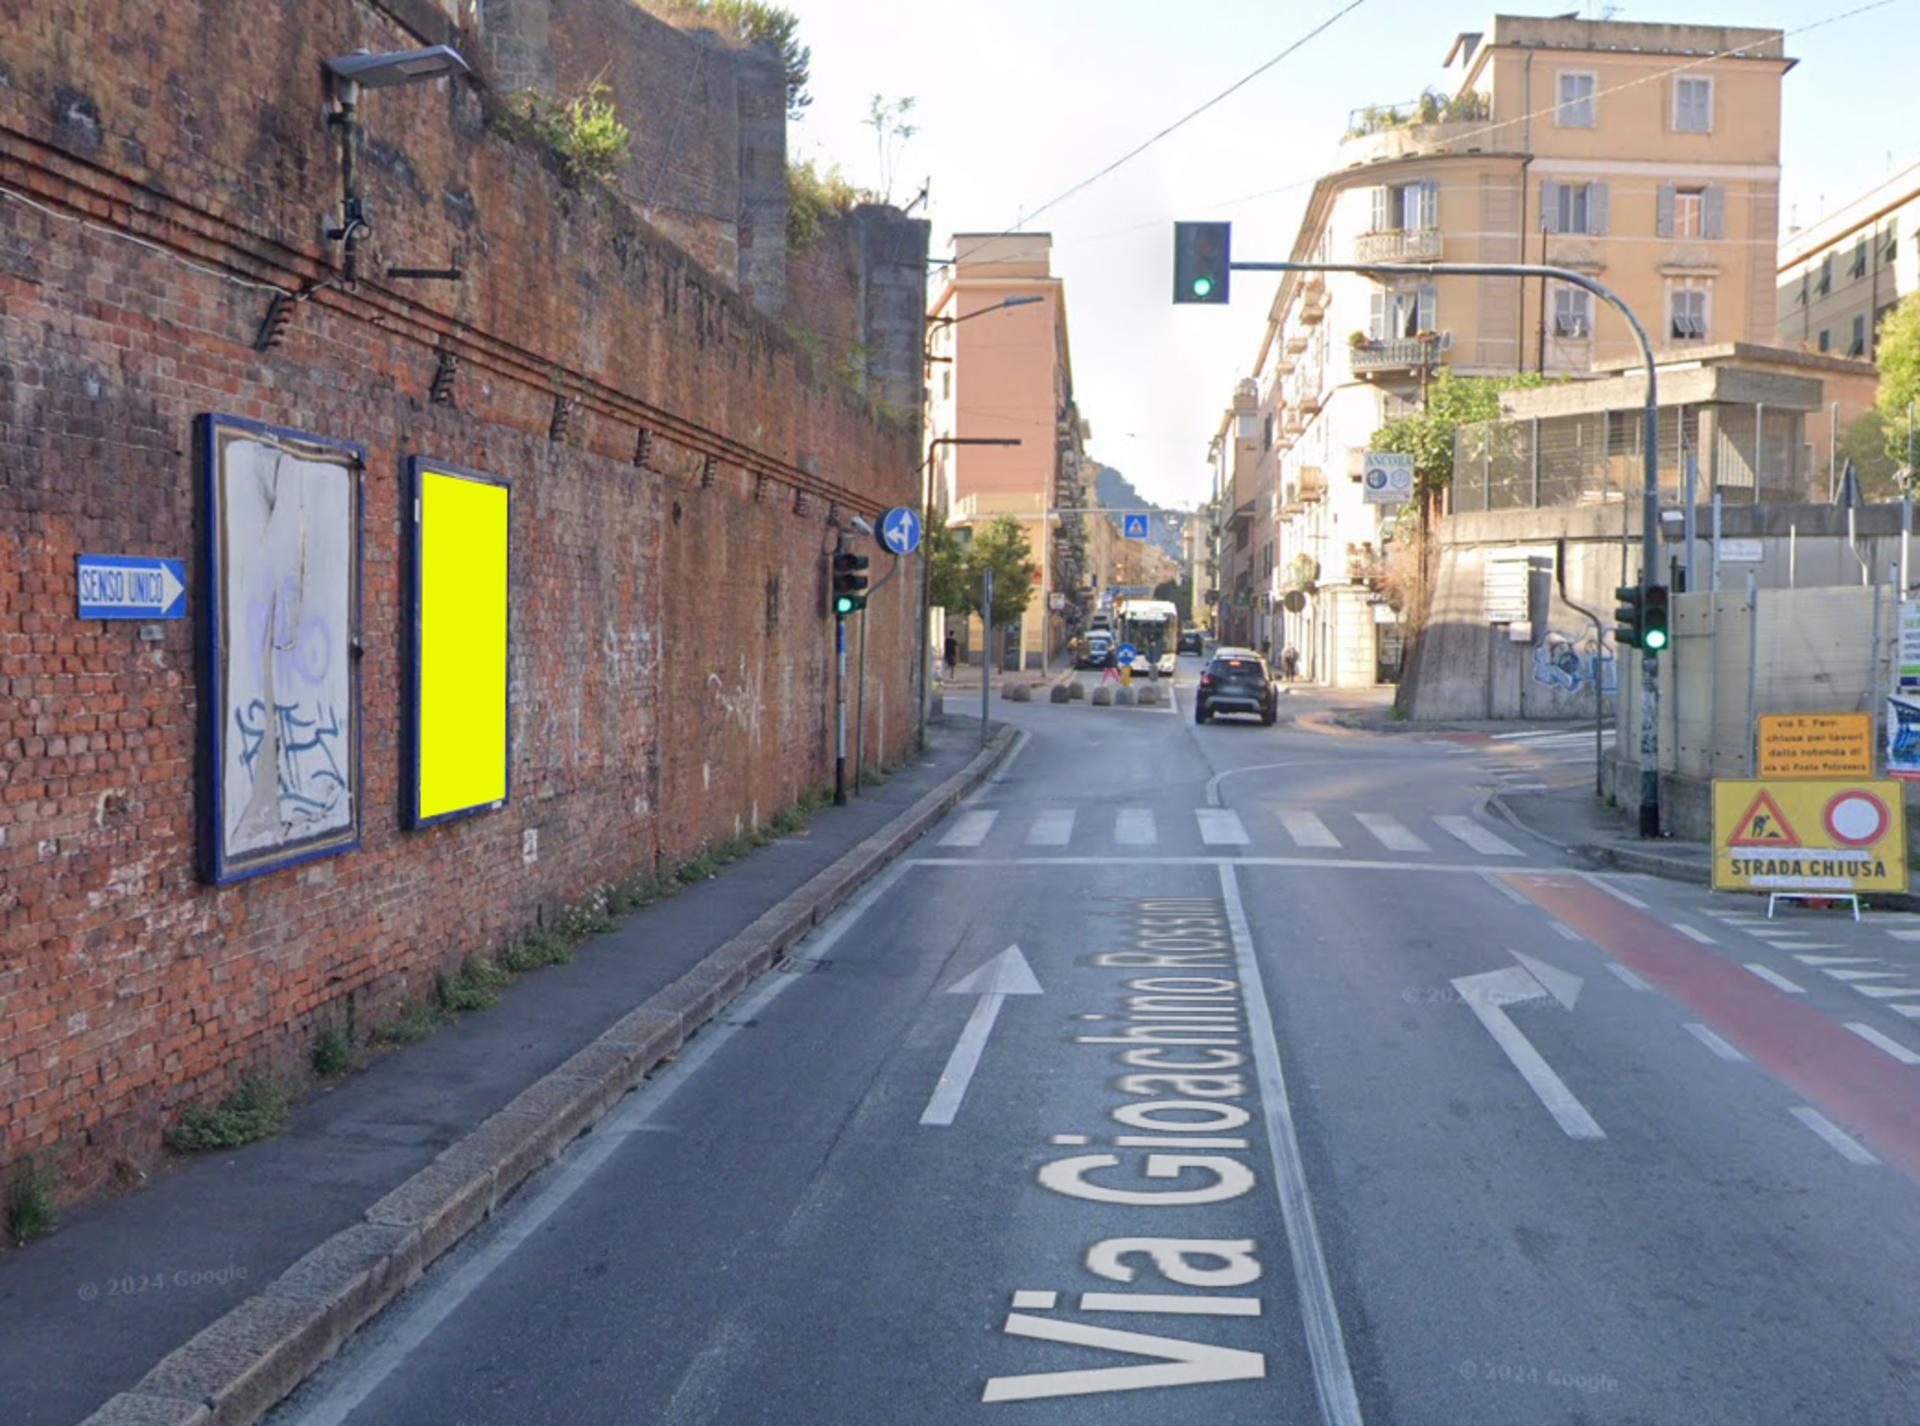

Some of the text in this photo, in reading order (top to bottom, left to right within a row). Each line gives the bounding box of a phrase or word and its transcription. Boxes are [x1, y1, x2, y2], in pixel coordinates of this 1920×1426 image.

[81, 568, 163, 603] SENSO UNICO
[1766, 733, 1863, 743] chiusa per lavori
[1801, 748, 1846, 757] rotonda
[1850, 748, 1862, 756] di
[1731, 858, 1886, 877] STRADA CHIUSA
